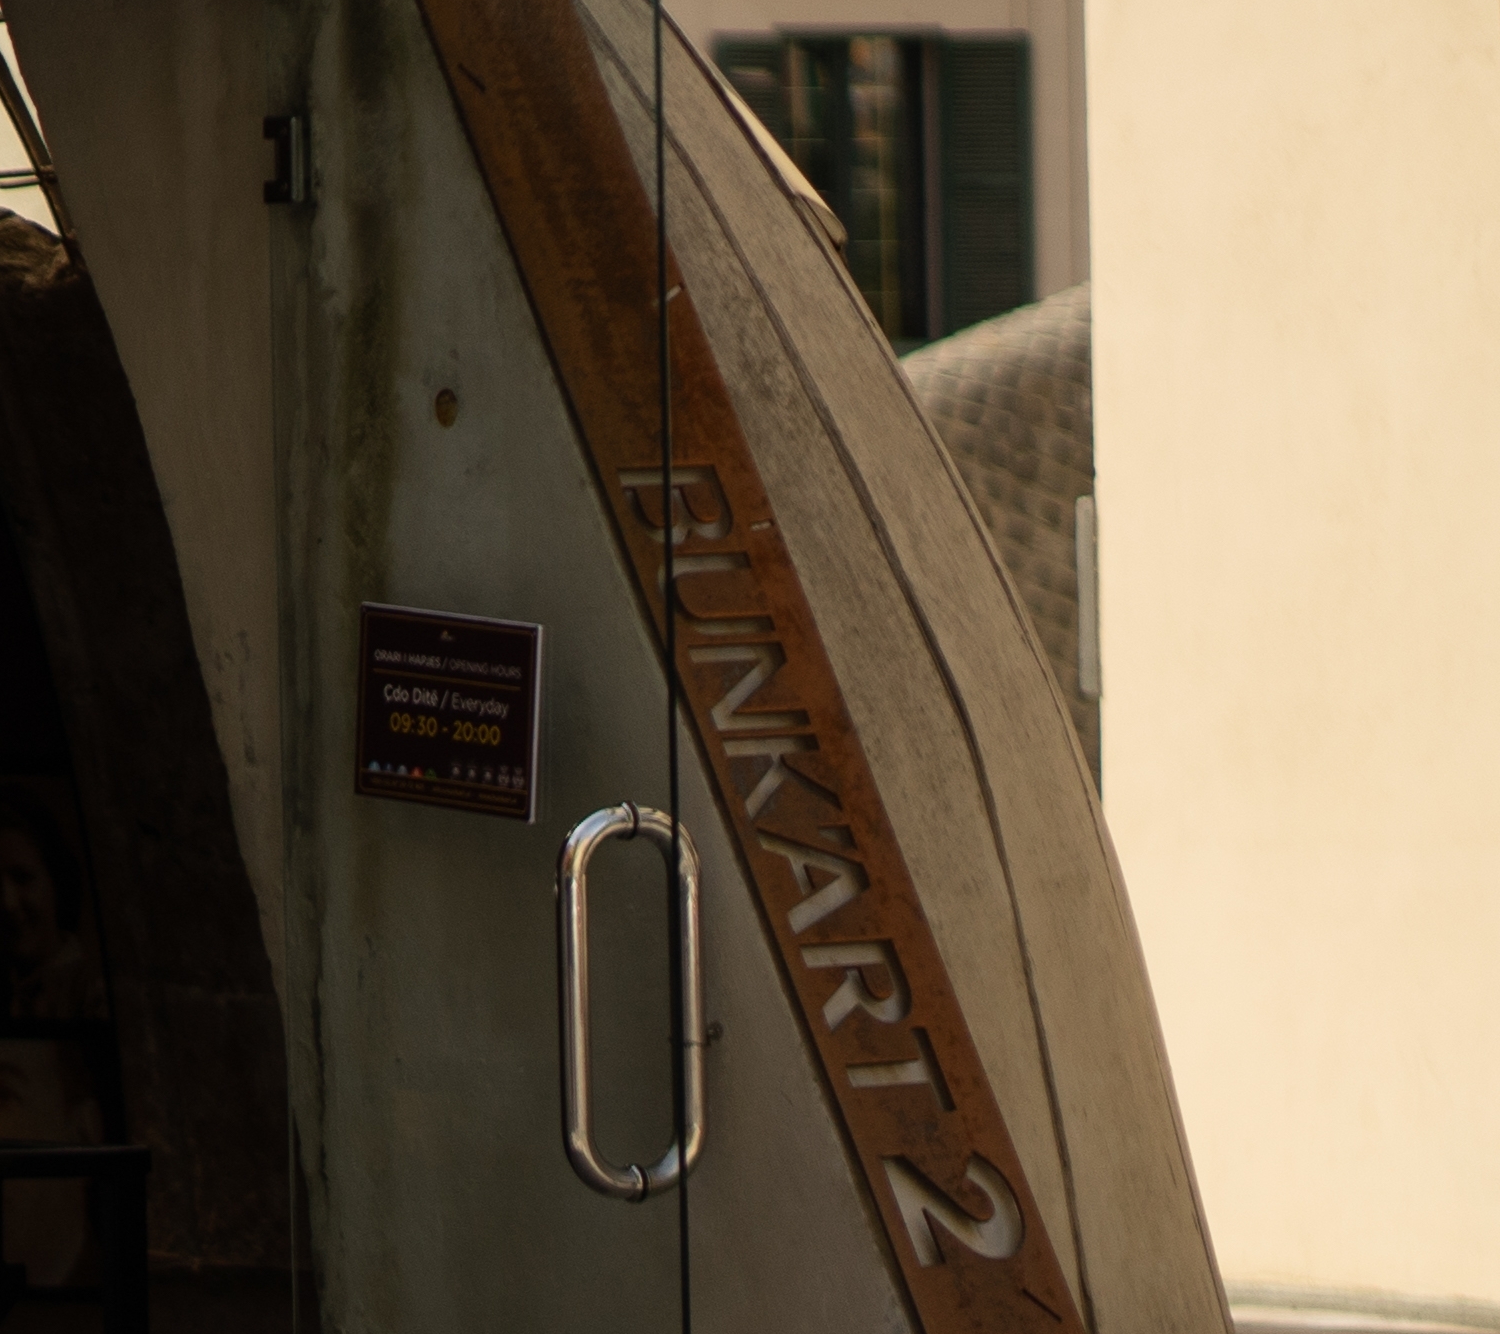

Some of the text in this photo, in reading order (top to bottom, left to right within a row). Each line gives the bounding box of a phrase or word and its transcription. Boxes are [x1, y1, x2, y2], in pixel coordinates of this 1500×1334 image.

[449, 658, 488, 676] OPENING
[490, 663, 523, 680] HOURS
[451, 692, 509, 718] Everyday
[389, 712, 438, 737] 09:30
[453, 720, 500, 746] 20:00
[618, 465, 1028, 1270] BUNK'ART 2
